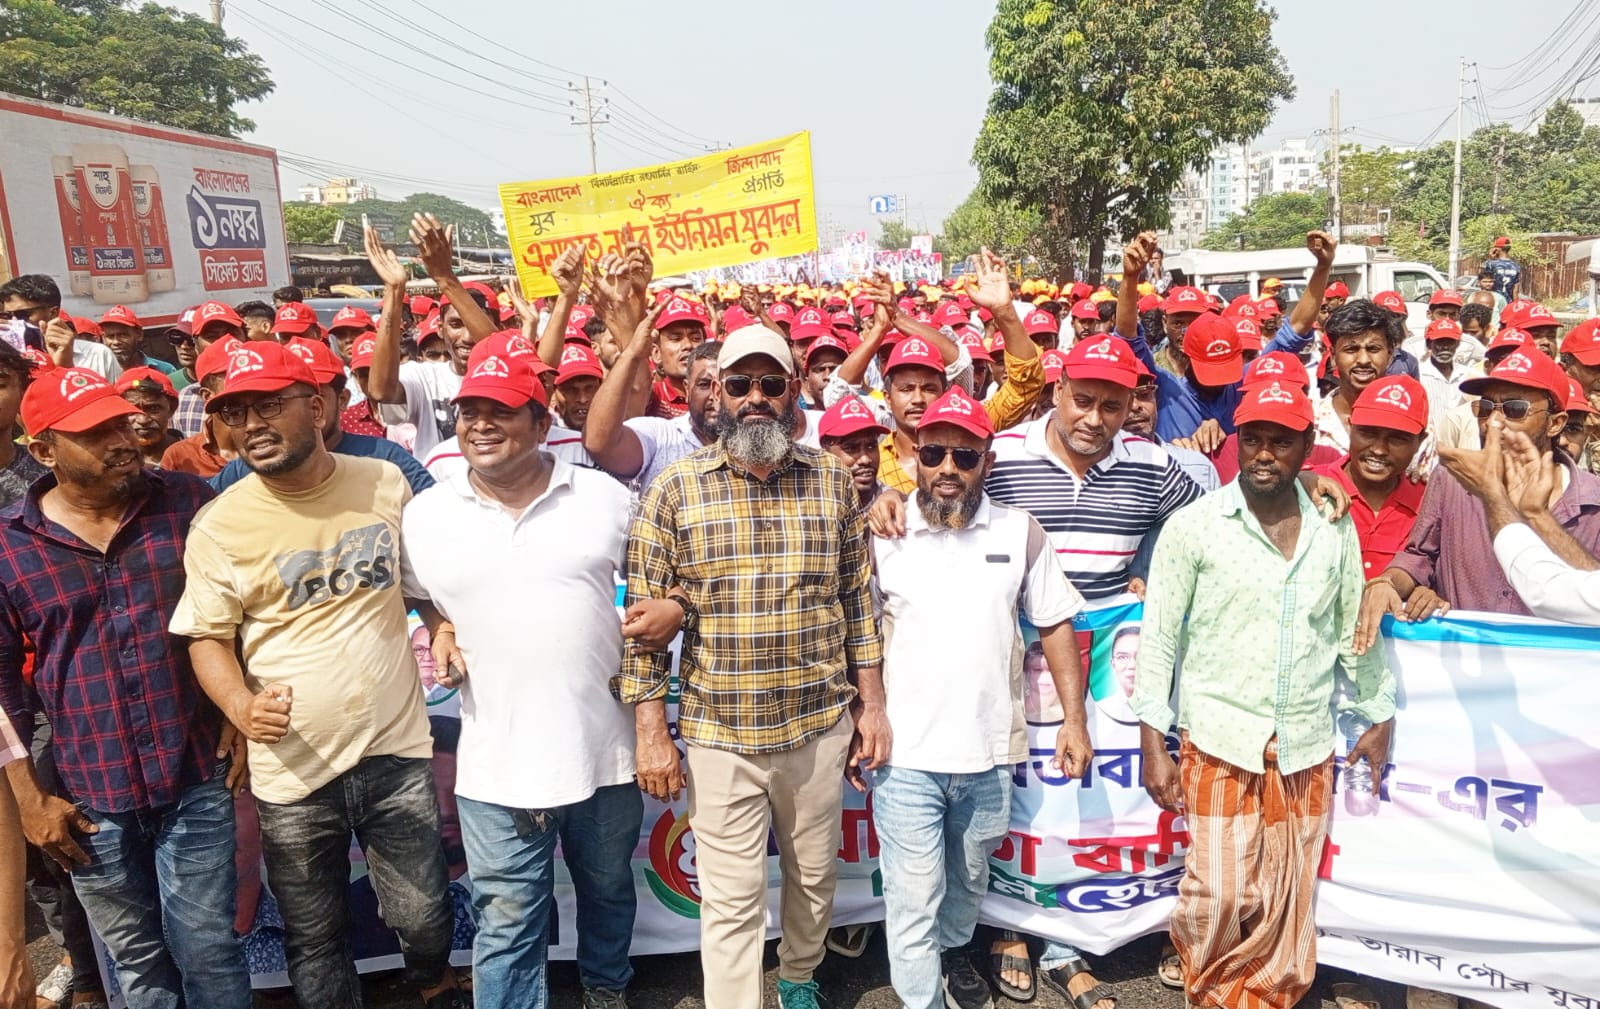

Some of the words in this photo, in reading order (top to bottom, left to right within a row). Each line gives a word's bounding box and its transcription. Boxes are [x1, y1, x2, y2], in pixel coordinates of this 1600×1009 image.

[193, 168, 250, 193] বাংলাদেশের
[724, 149, 784, 175] জিন্দাবাদ
[192, 188, 218, 247] ১
[216, 204, 259, 242] নম্বর
[516, 184, 582, 209] বাংলাদেশ
[529, 210, 556, 236] যুব
[742, 169, 785, 193] প্রগতি
[649, 207, 739, 254] ইউনিয়ন
[739, 199, 801, 255] যুবদল
[205, 256, 238, 283] সিমেন্ট
[303, 556, 390, 605] BOSS
[1356, 935, 1446, 971] তারাব
[1457, 962, 1533, 994] পৌর
[1542, 984, 1600, 1009] যুব
